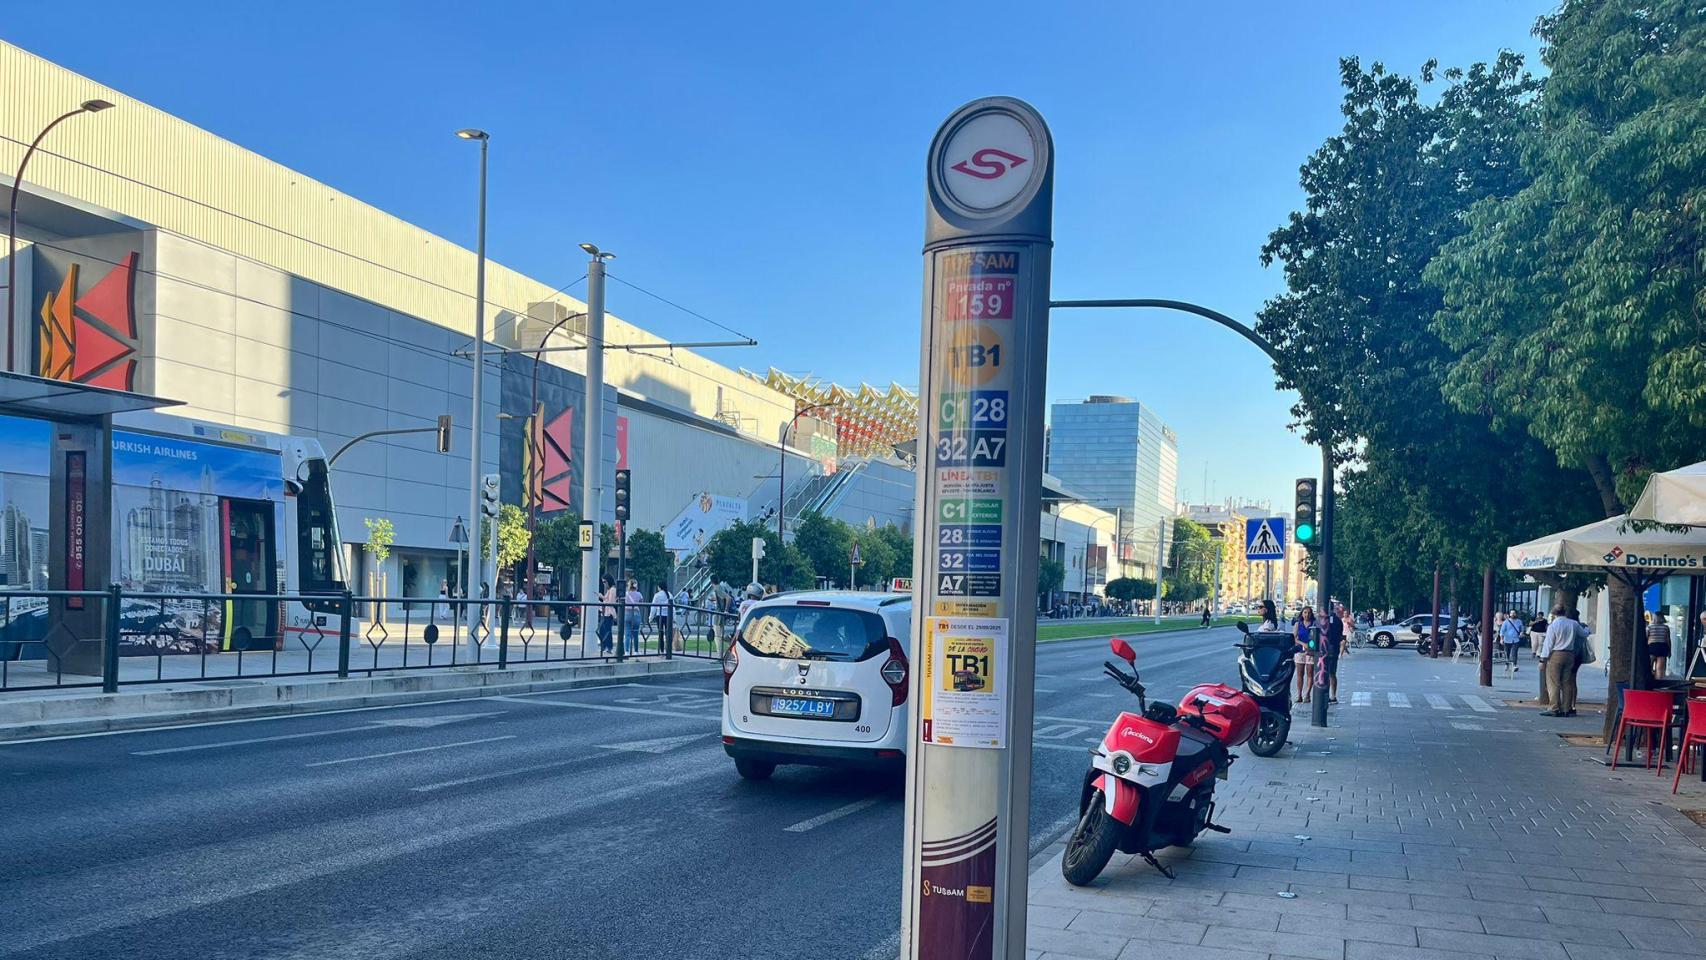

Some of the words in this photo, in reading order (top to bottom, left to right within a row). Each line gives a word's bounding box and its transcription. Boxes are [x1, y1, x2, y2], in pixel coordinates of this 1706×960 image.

[949, 281, 993, 293] Parada
[958, 294, 1003, 316] 159
[948, 344, 1000, 367] TB1
[941, 399, 967, 422] C1
[972, 398, 1005, 422] 28
[112, 440, 151, 453] URKISH
[154, 447, 198, 461] AIRLINES
[938, 437, 967, 460] 32
[971, 438, 1005, 460] A7
[942, 502, 966, 518] C1
[581, 529, 591, 543] 15
[940, 528, 963, 544] 28
[75, 538, 83, 560] 955
[145, 554, 185, 572] DUBÁI
[941, 553, 964, 568] 32
[1626, 554, 1697, 567] Domino's
[940, 575, 964, 590] A7
[946, 654, 989, 677] TB1
[782, 688, 820, 696] LODGY
[778, 699, 807, 711] 9257
[809, 701, 832, 713] LBY
[854, 725, 871, 733] 400
[931, 885, 965, 897] TUSSAM
